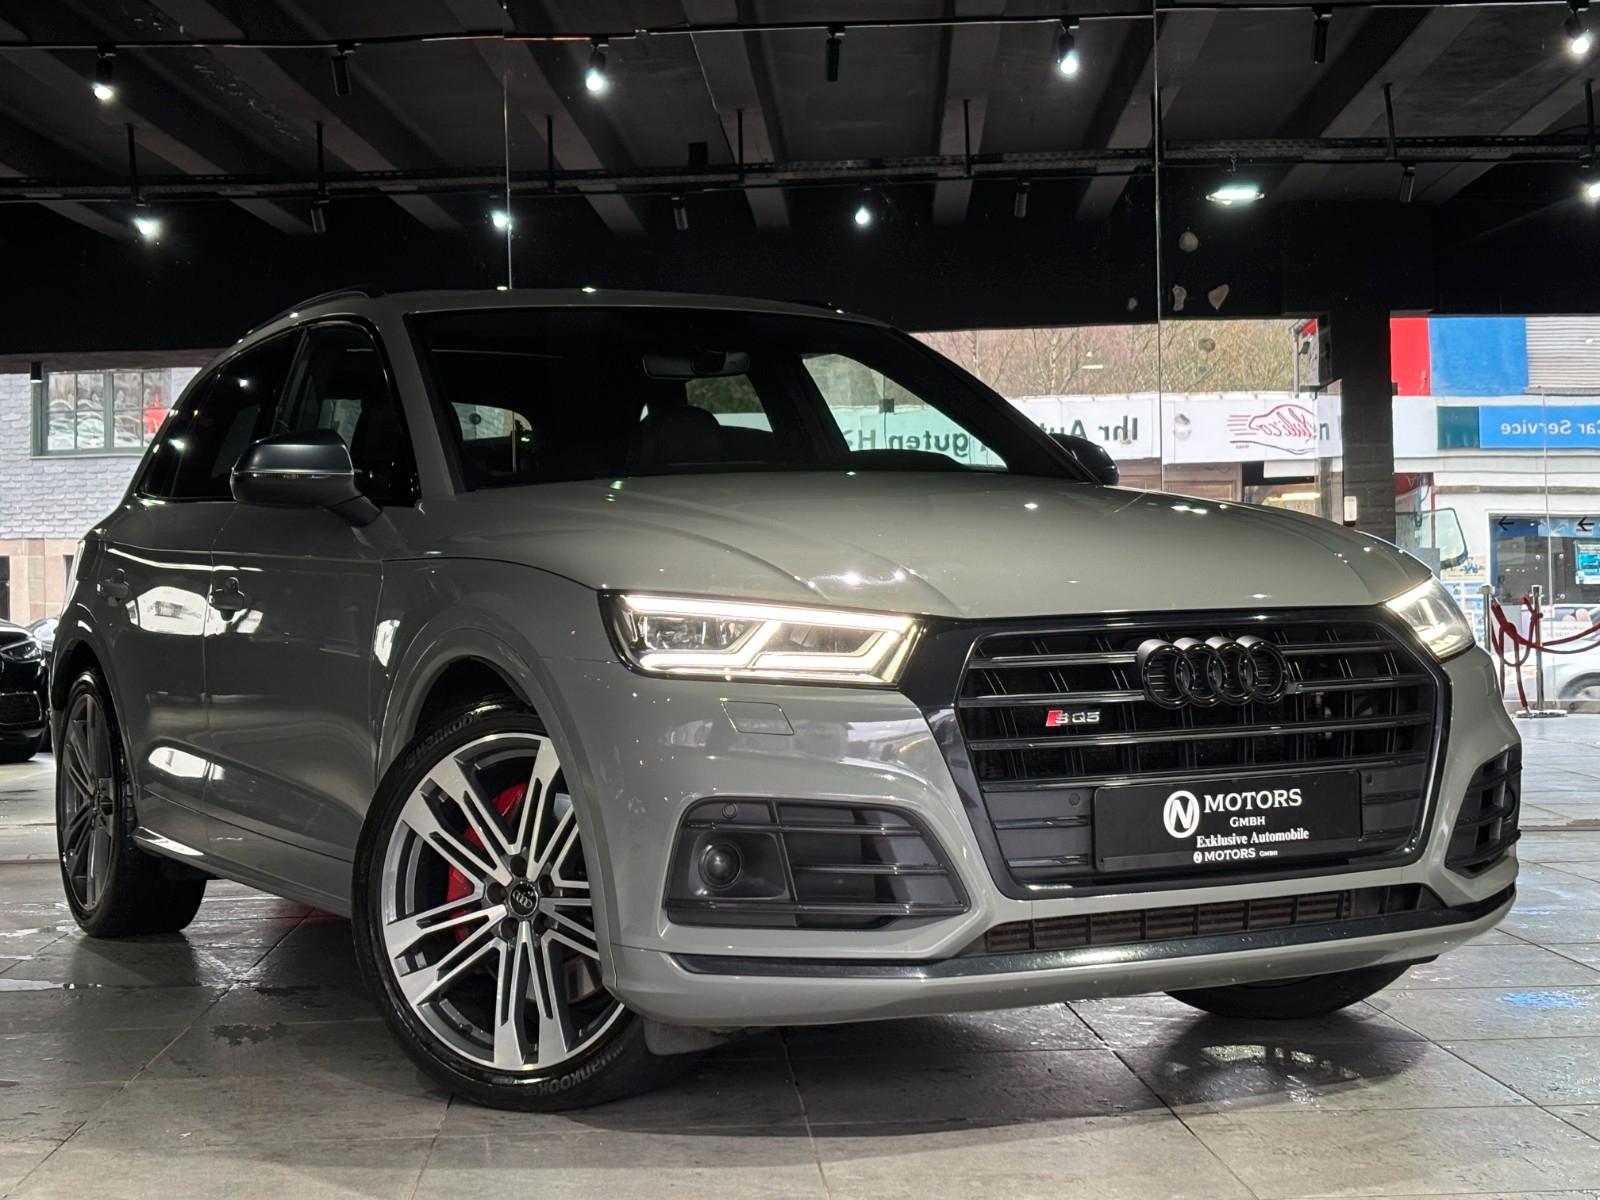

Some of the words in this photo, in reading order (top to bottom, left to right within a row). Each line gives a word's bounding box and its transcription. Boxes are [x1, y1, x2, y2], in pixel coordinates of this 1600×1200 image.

[1054, 711, 1100, 724] SQ5
[1203, 788, 1303, 813] MOTORS
[1229, 815, 1266, 828] GMBH
[1196, 832, 1248, 849] Exklusive
[1250, 827, 1310, 845] Automobile
[1203, 848, 1256, 862] MOTORS
